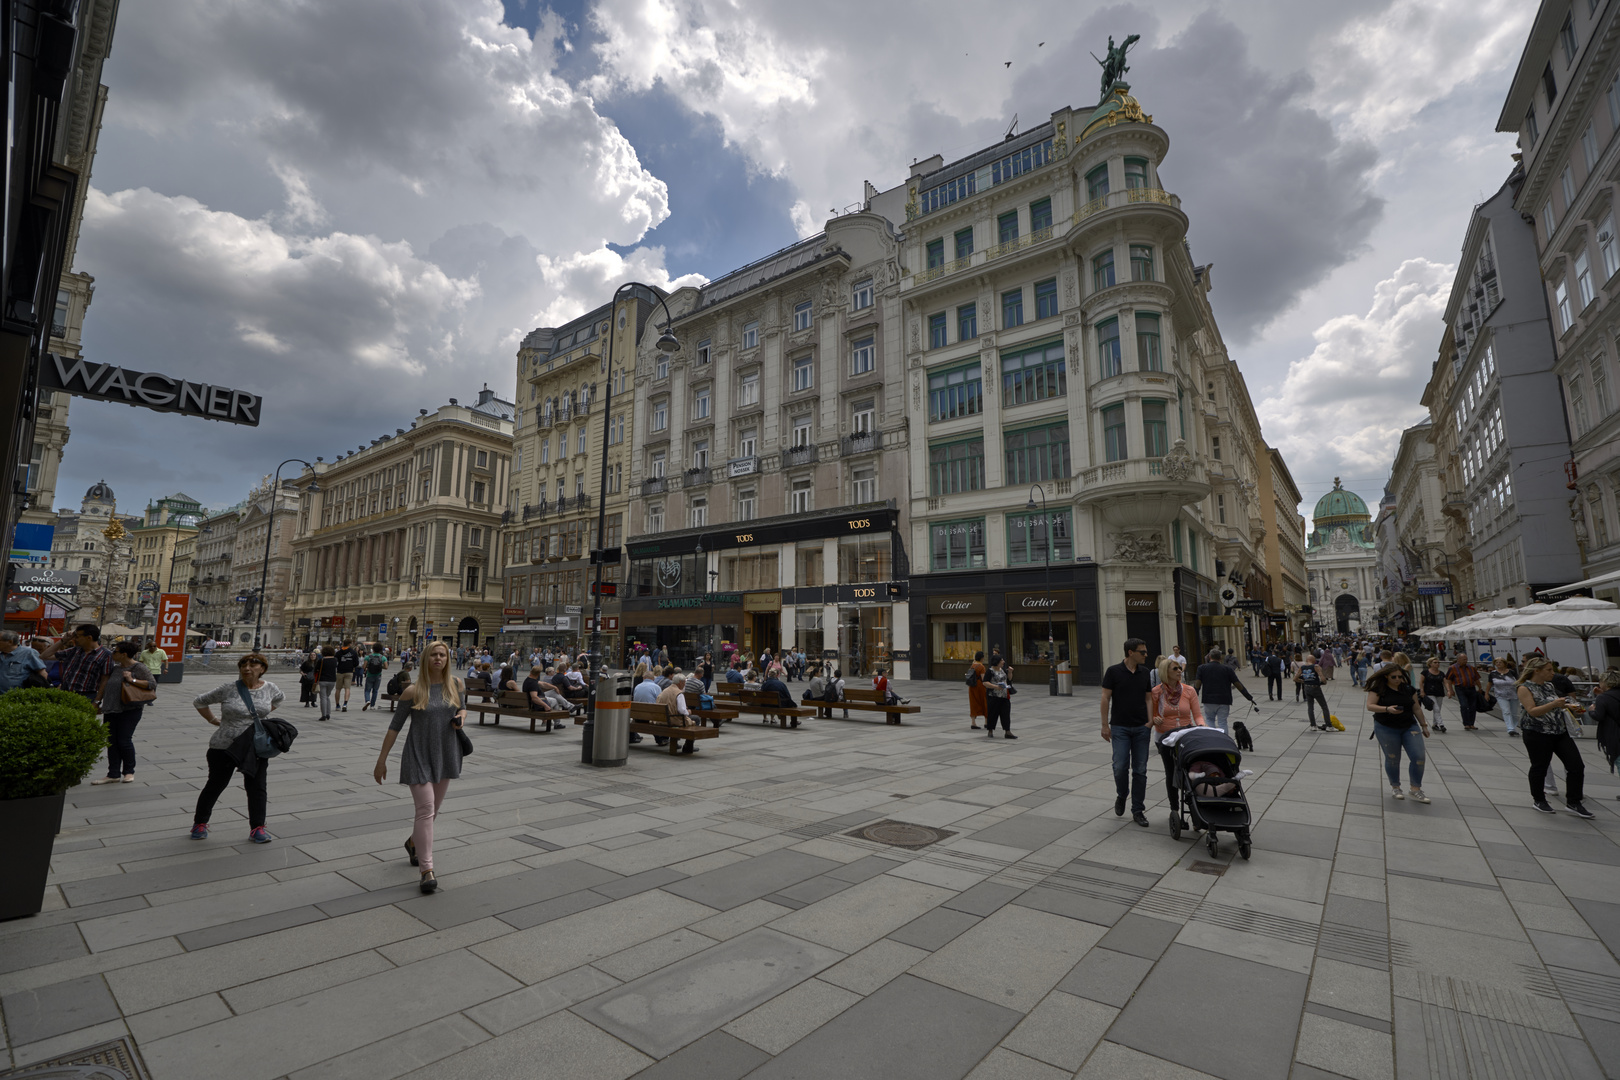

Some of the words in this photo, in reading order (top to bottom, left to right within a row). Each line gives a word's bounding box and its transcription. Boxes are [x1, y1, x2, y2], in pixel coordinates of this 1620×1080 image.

[52, 352, 257, 422] WAGNER
[848, 518, 871, 529] TOD'S
[736, 534, 754, 543] TOD'S
[19, 585, 41, 593] VON
[43, 585, 72, 594] KÖCK
[853, 588, 876, 598] TOD'S
[658, 597, 703, 608] SALAMANDER
[940, 599, 972, 610] Cartier
[1127, 597, 1154, 607] Cartier
[160, 600, 183, 648] FEST
